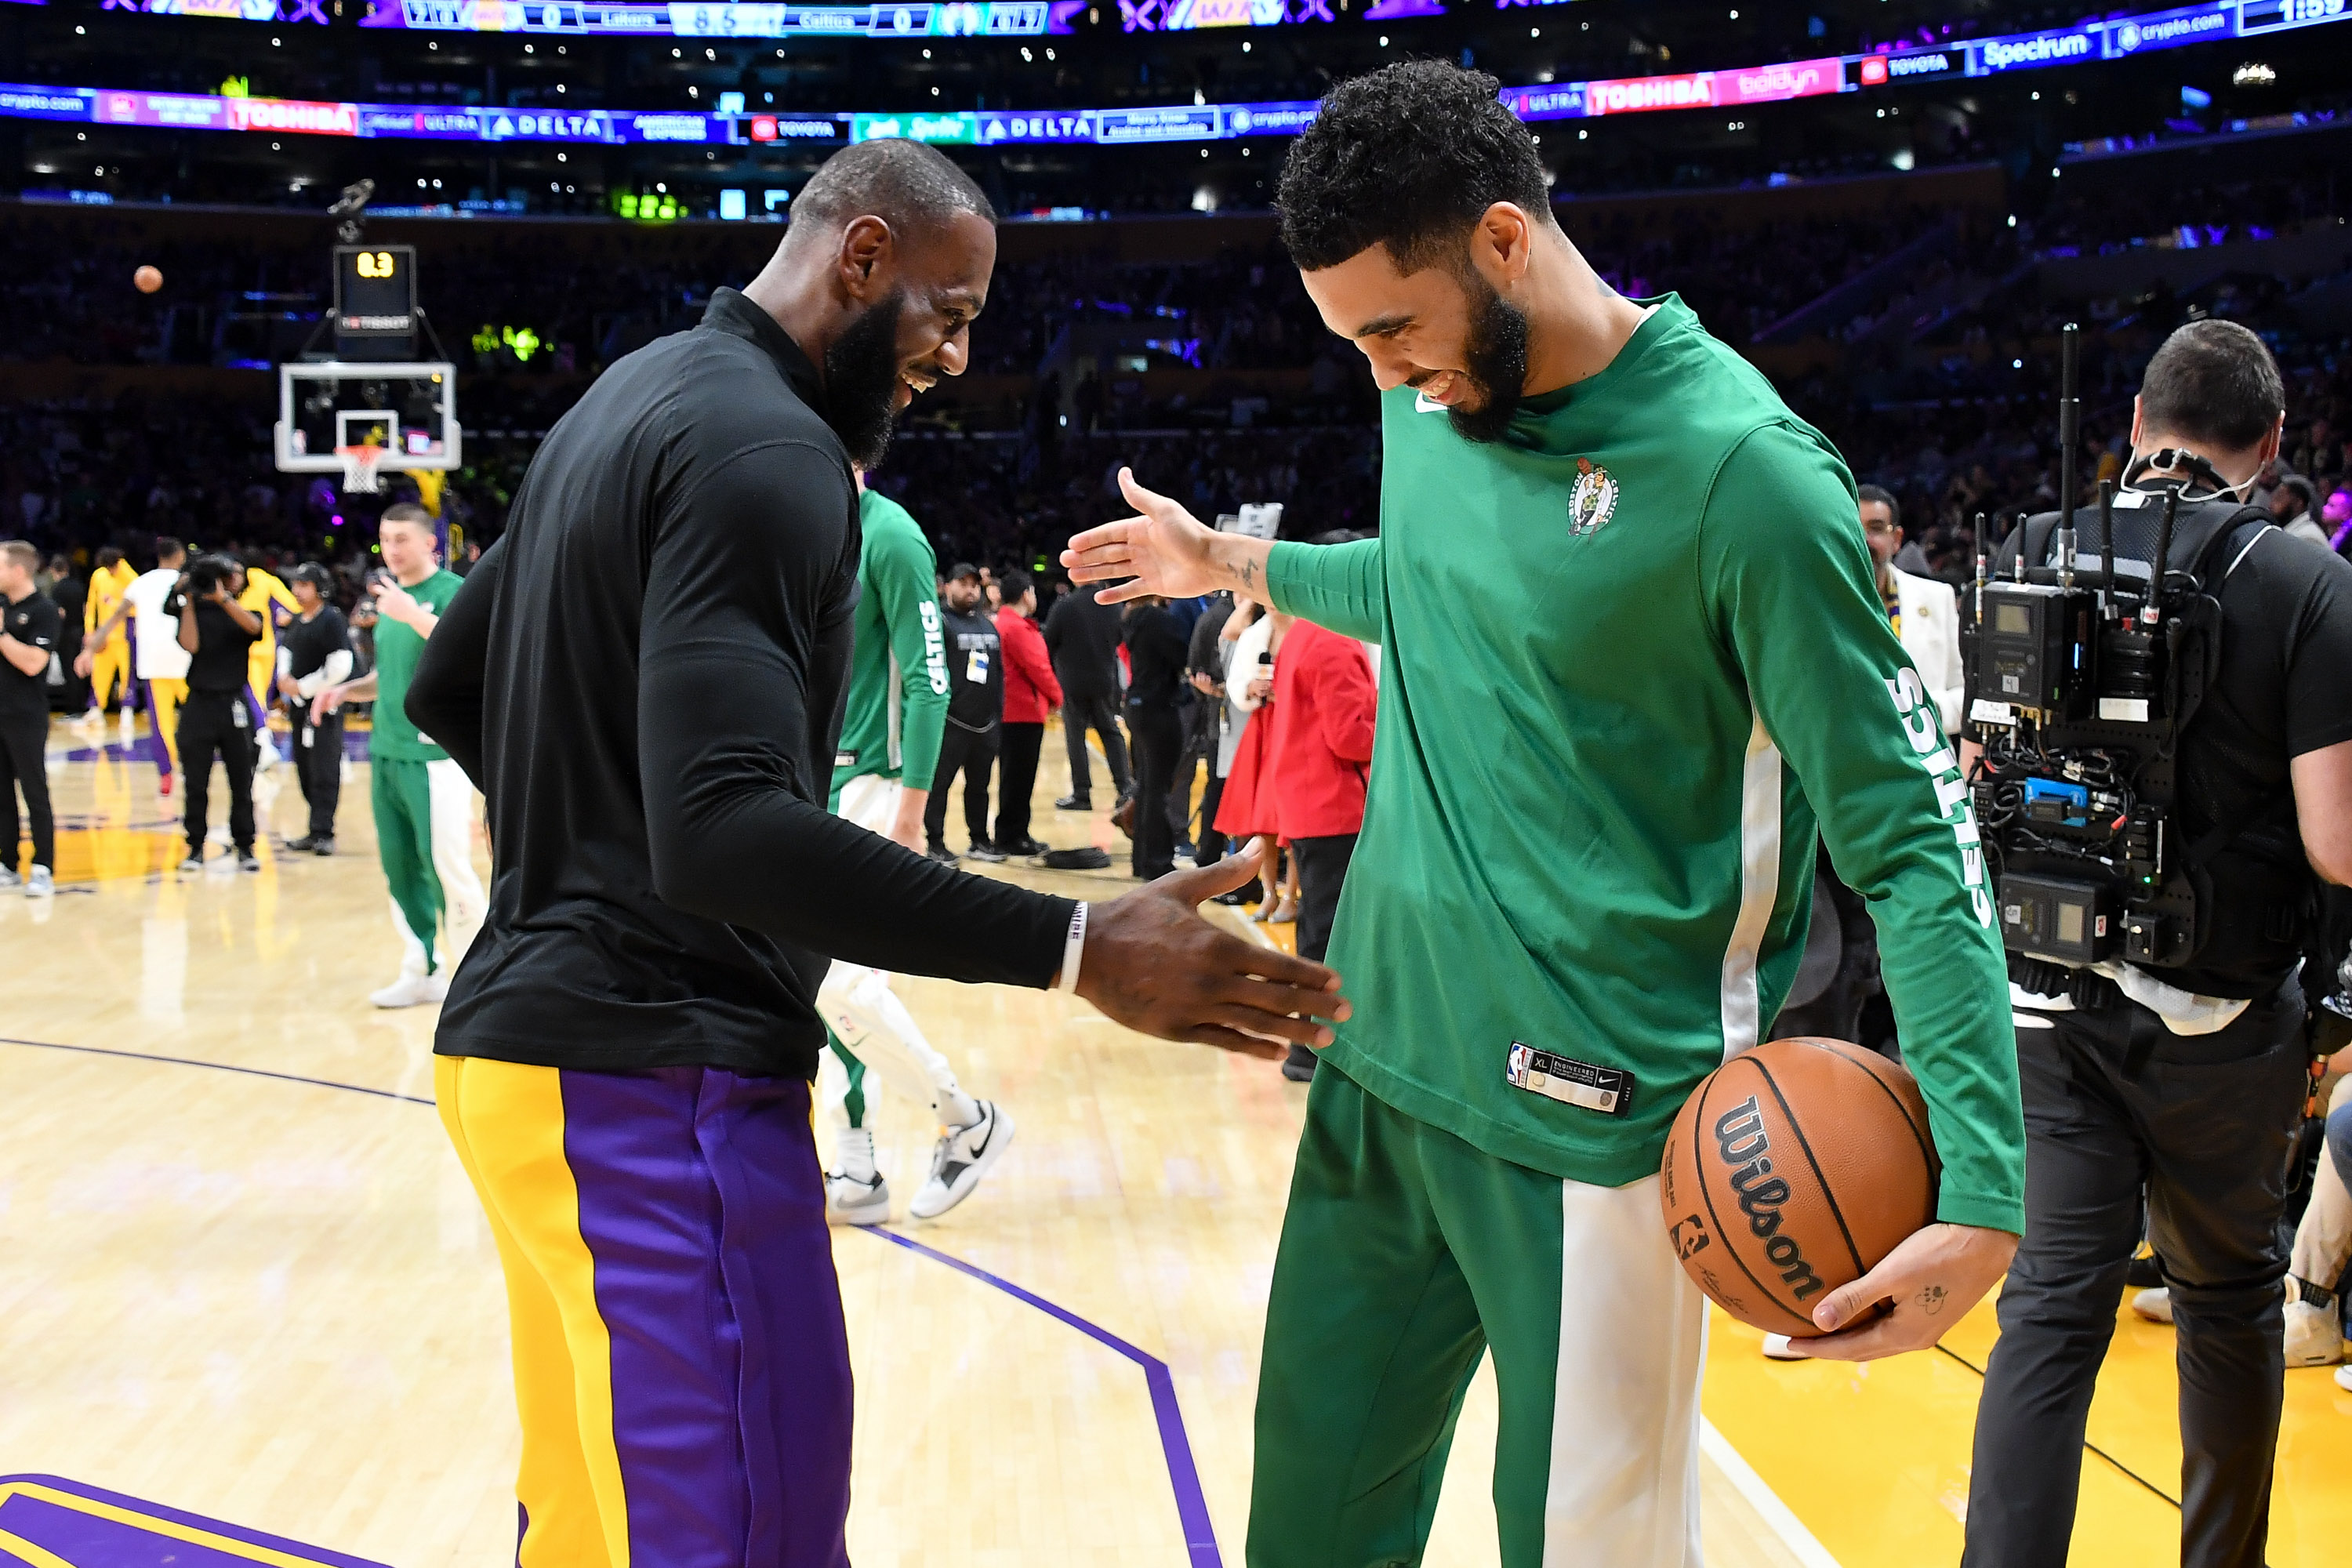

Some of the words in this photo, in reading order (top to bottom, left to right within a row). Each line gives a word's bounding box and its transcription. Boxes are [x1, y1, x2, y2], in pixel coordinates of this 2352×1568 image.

[543, 4, 561, 29] 0
[894, 8, 912, 33] 0
[2142, 13, 2225, 41] crypto.com
[1984, 34, 2087, 68] Spectrum
[1889, 54, 1949, 76] TOYOTA
[1530, 93, 1582, 111] ULTRA
[1592, 79, 1710, 110] TOSHIBA
[234, 103, 354, 131] TOSHIBA
[423, 114, 478, 132] ULTRA
[518, 115, 601, 136] DELTA
[778, 121, 835, 137] TOYOTA
[1011, 117, 1091, 137] DELTA
[1568, 472, 1584, 516] BOSTON
[1601, 479, 1619, 524] CELTICS
[919, 601, 948, 695] CELTICS
[1883, 667, 1992, 929] CELTICS
[1534, 1057, 1548, 1069] XL
[1554, 1060, 1595, 1076] ENGINEERED
[1715, 1094, 1825, 1301] Wilson
